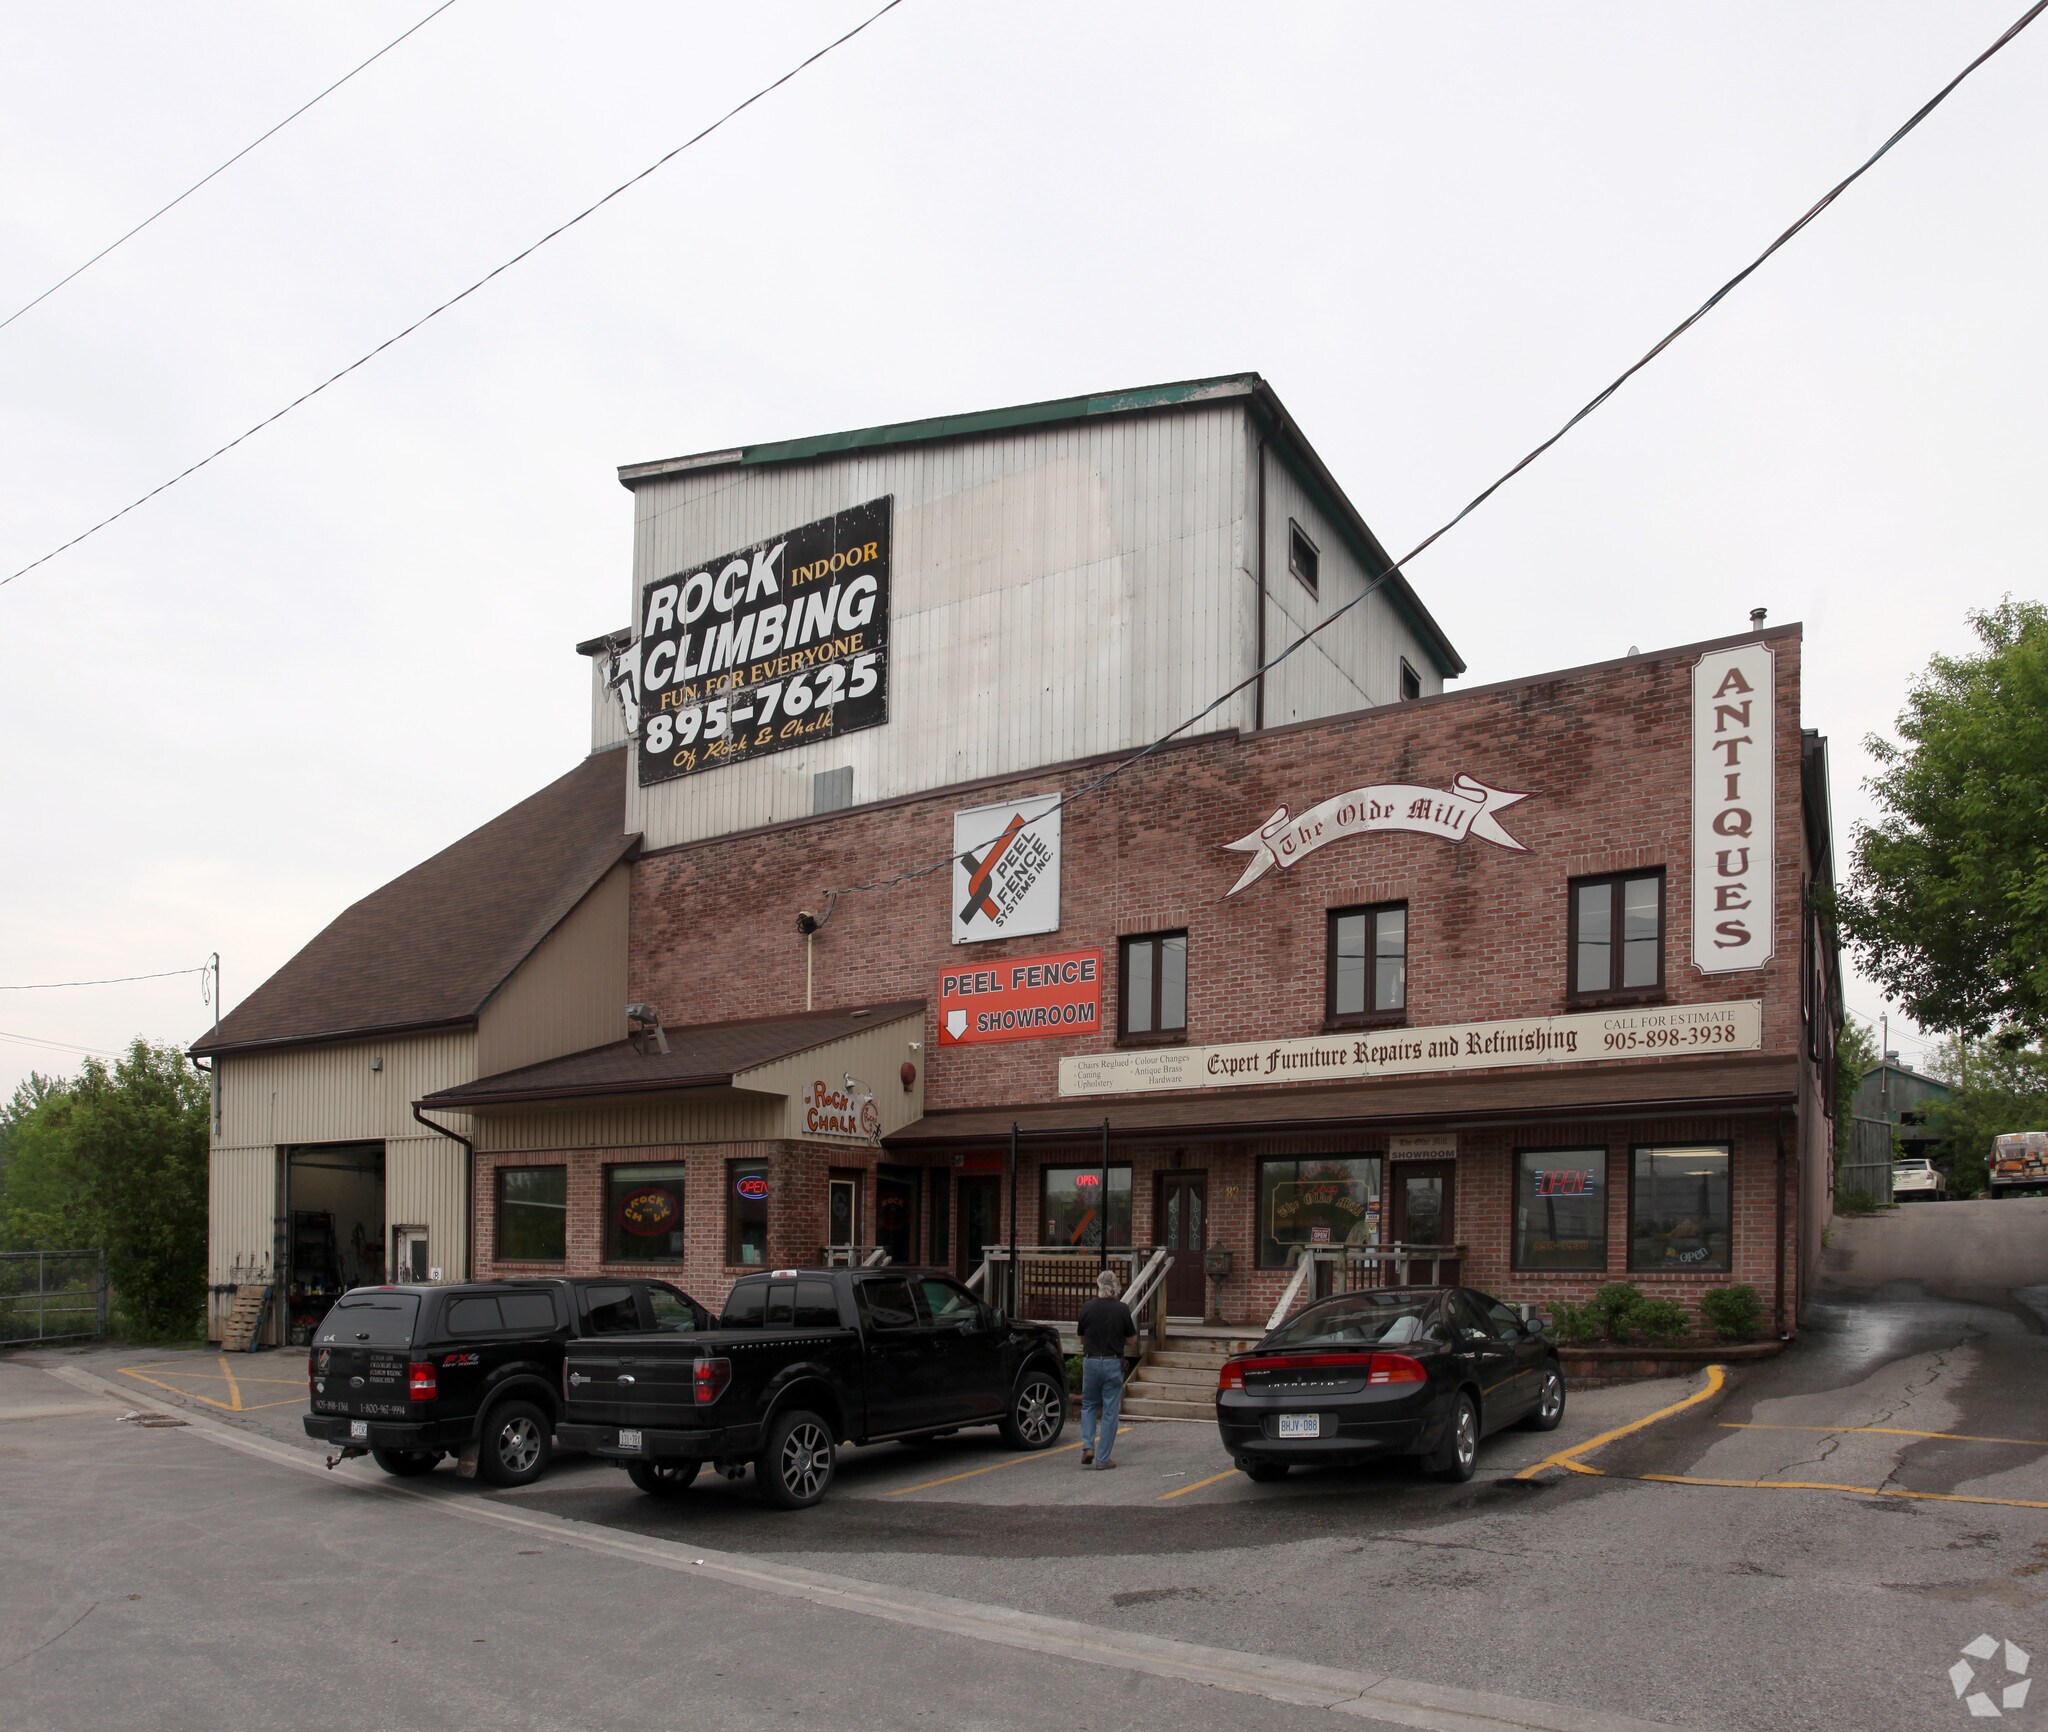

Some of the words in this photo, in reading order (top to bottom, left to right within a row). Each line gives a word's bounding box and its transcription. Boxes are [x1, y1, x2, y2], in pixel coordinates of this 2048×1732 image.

[644, 541, 788, 637] ROCK
[791, 541, 878, 587] INDOOR
[644, 574, 878, 691] CLIMBING
[660, 684, 698, 711] FUN
[705, 671, 745, 693] FOR
[751, 632, 864, 683] EVERYONE
[645, 653, 878, 754] 895-7625
[673, 749, 697, 771] Of
[703, 734, 747, 760] Rock
[754, 730, 773, 747] &
[780, 711, 833, 739] Chalk
[1712, 667, 1754, 949] ANTIQUES
[1278, 820, 1324, 856] The
[1336, 800, 1395, 827] Olde
[1406, 797, 1467, 830] Mill
[996, 832, 1036, 879] PEEL
[996, 837, 1047, 905] FENCE
[995, 873, 1036, 927] SYSTEMS
[1034, 851, 1054, 874] INC.
[943, 971, 1004, 997] PEEL
[1011, 958, 1098, 990] FENCE
[976, 1002, 1096, 1032] SHOWROOM
[1603, 1018, 1638, 1031] CALL
[1641, 1016, 1666, 1028] FOR
[1670, 1010, 1736, 1026] ESTIMATE
[1603, 1024, 1736, 1051] 905-898-3938
[1077, 1062, 1099, 1070] Chairs
[1101, 1059, 1129, 1070] Reglued
[1134, 1057, 1158, 1066] Colour
[1160, 1054, 1190, 1064] Changes
[1207, 1052, 1260, 1077] Expert
[1264, 1046, 1348, 1075] Furniture
[1352, 1039, 1423, 1067] Repairs
[1428, 1035, 1460, 1059] and
[1465, 1026, 1578, 1057] Refinishing
[1077, 1070, 1101, 1080] Caning
[1134, 1067, 1161, 1076] Antique
[1163, 1065, 1183, 1074] Brass
[1148, 1075, 1183, 1085] Hardware
[1077, 1079, 1114, 1090] Upholstery
[807, 1107, 857, 1135] CHALK
[1392, 1150, 1455, 1159] SHOWROOM
[740, 1180, 768, 1193] OPEN
[1076, 1174, 1099, 1187] OPEN
[1539, 1170, 1588, 1194] OPEN
[631, 1195, 664, 1208] ROCK
[1313, 1231, 1328, 1239] OPEN
[444, 1353, 480, 1364] FX4
